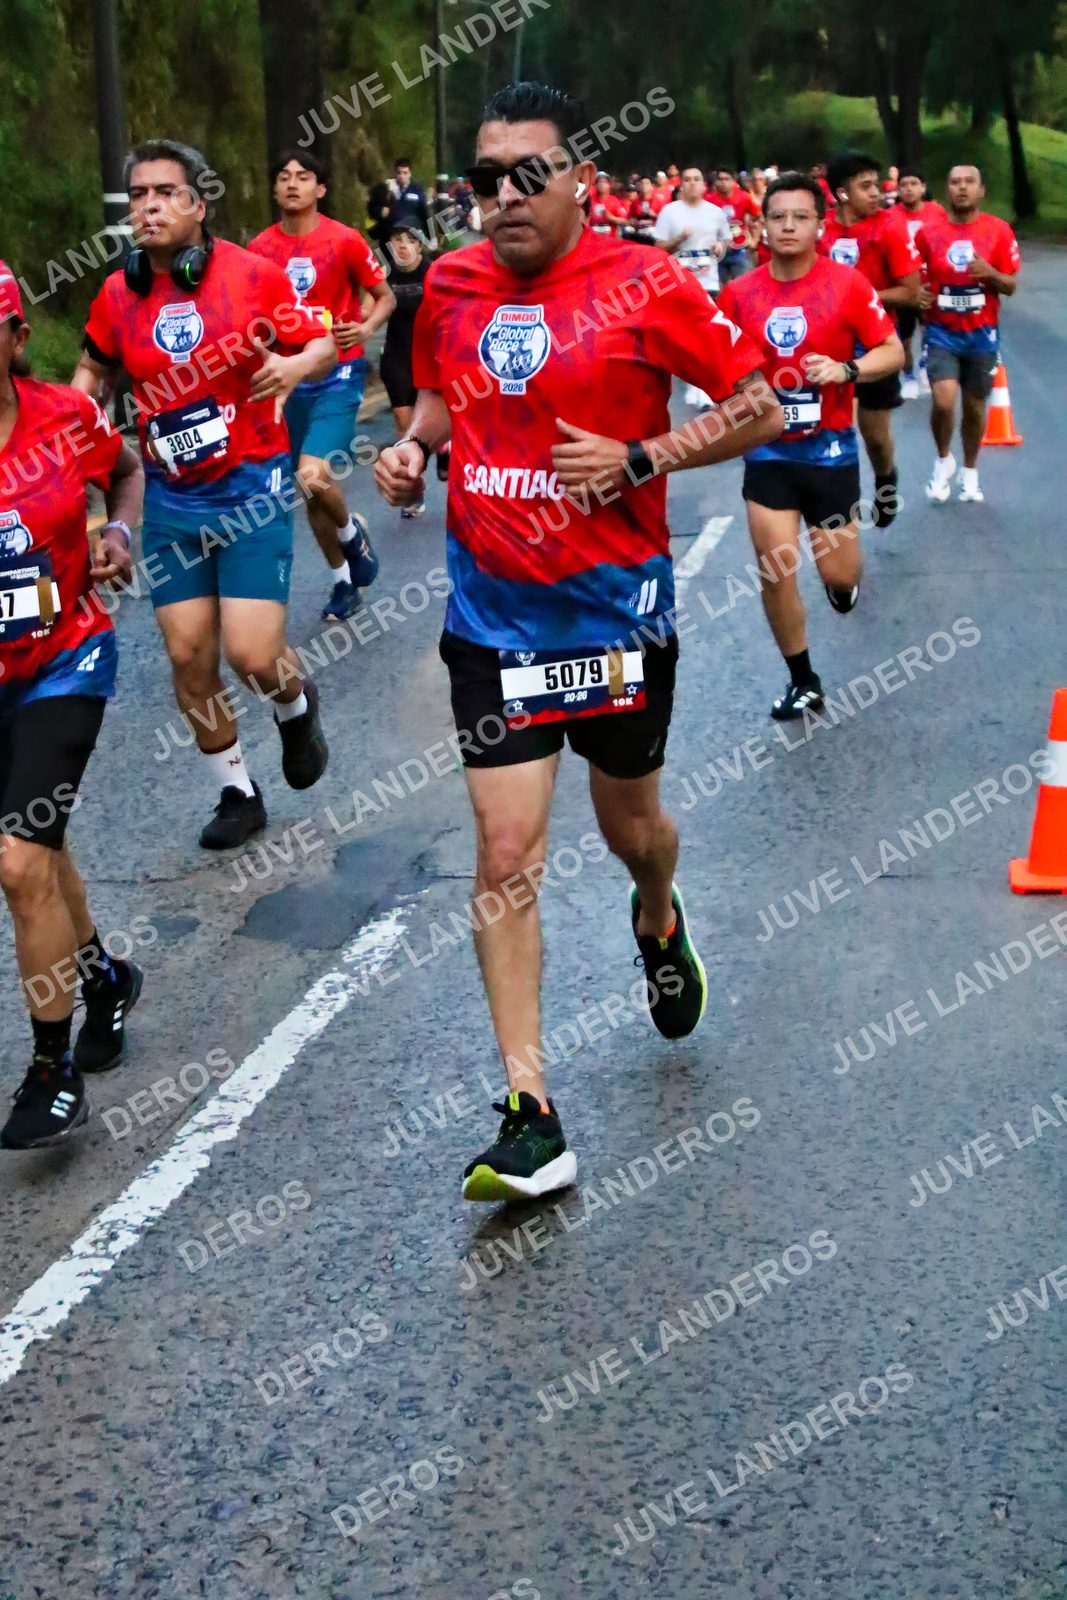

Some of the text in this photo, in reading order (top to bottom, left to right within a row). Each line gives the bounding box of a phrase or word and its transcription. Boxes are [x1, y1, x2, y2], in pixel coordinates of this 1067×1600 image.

[165, 307, 190, 316] BIMBO
[500, 313, 537, 322] BIMBO
[498, 326, 535, 340] Global
[488, 340, 519, 351] Race
[502, 382, 524, 392] 2026
[166, 428, 203, 453] 3804
[544, 658, 603, 691] 5079
[563, 690, 588, 703] 20-26
[612, 697, 634, 707] 10K
